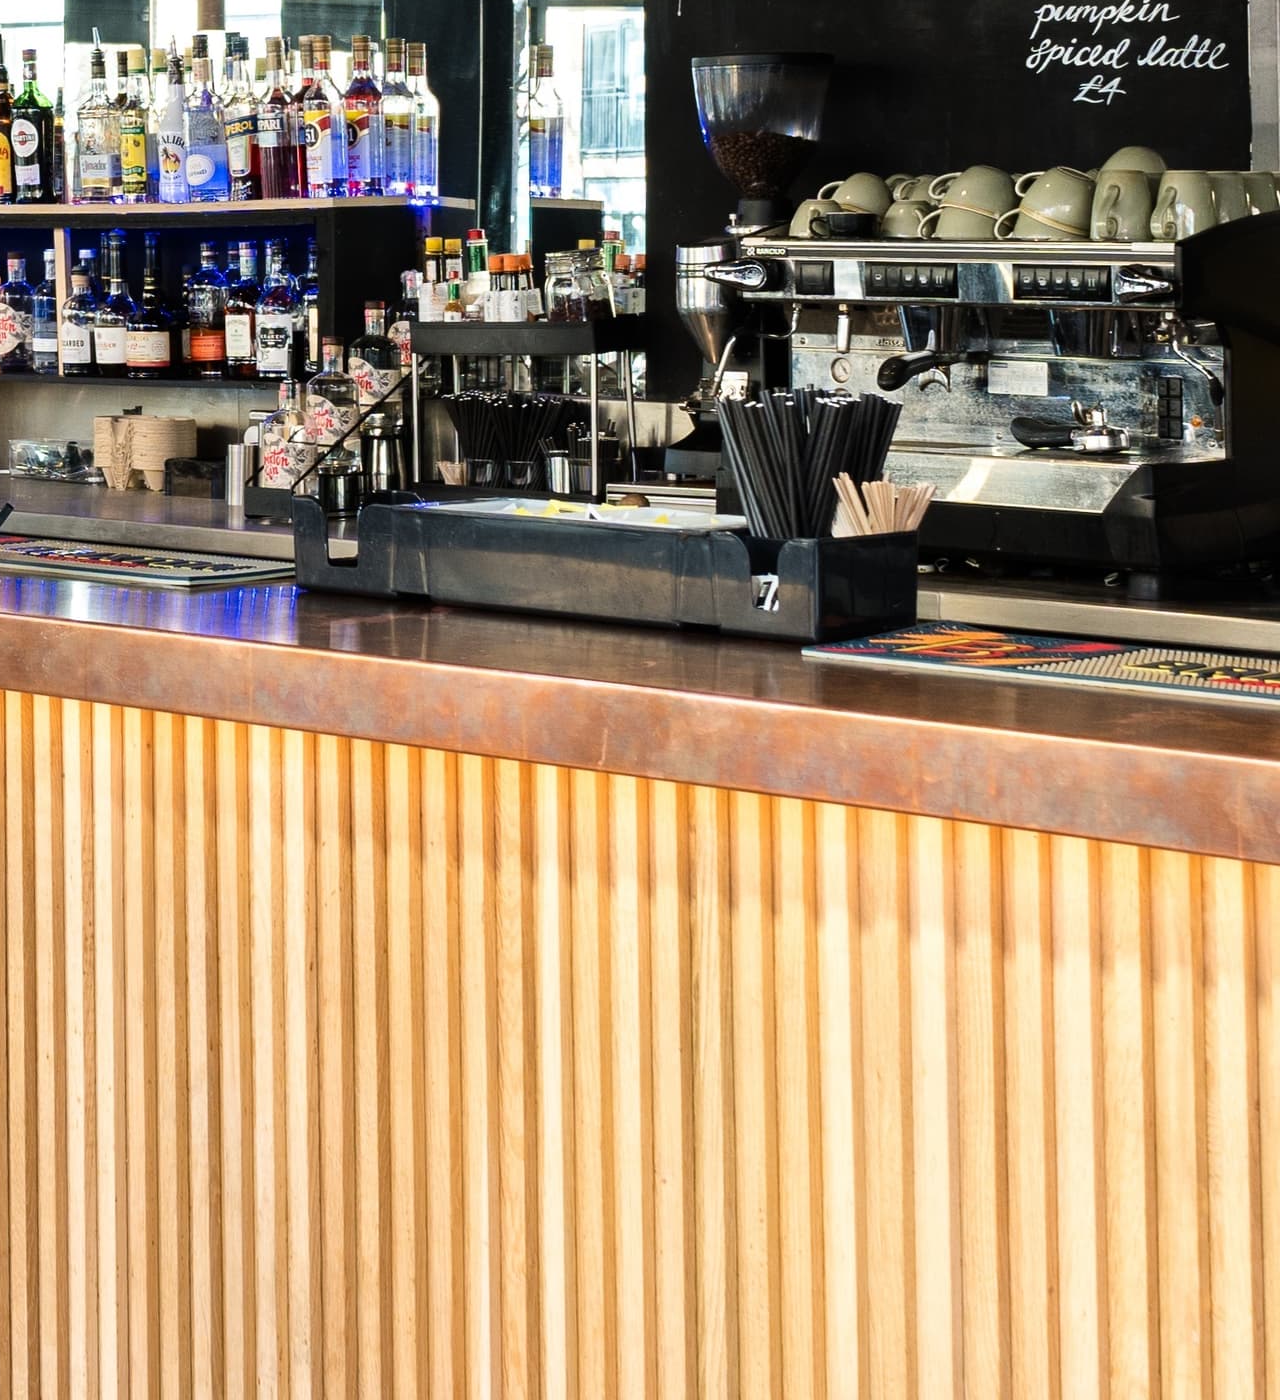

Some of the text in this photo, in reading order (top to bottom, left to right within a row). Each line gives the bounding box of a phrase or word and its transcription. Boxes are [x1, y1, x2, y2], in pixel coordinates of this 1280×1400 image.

[1025, 33, 1230, 75] spiced latte
[1072, 74, 1127, 106] £4
[305, 127, 316, 143] 51
